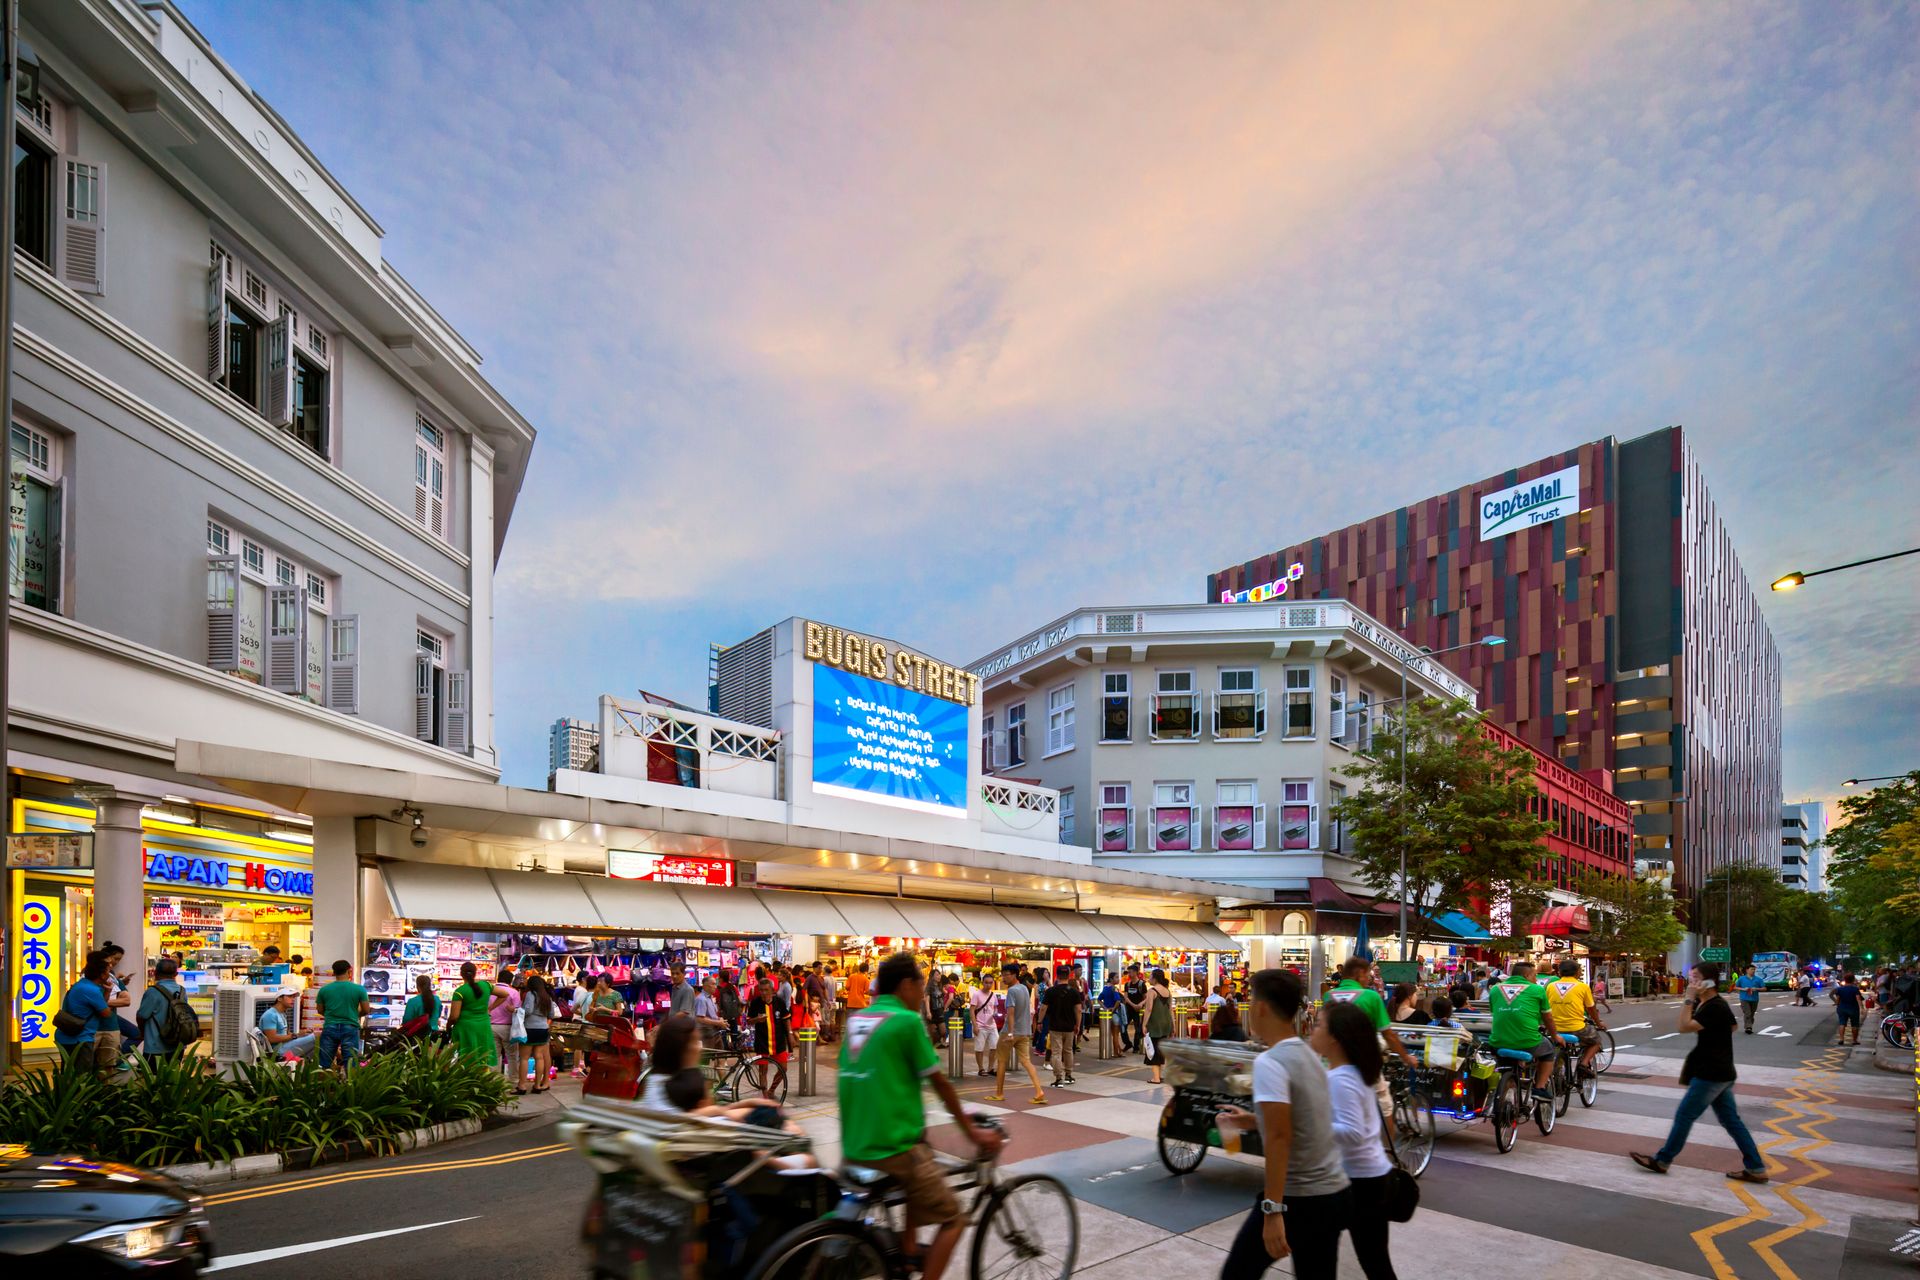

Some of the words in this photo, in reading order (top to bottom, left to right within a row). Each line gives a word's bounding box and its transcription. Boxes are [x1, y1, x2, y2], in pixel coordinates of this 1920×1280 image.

[1484, 478, 1561, 519] CapitaMall
[1528, 507, 1560, 524] Trust
[804, 620, 887, 679] BUGIS
[893, 650, 979, 706] STREET
[866, 715, 899, 732] CREATED
[847, 726, 878, 742] REALITY
[245, 862, 314, 895] HOME
[153, 906, 175, 916] SUPER
[181, 906, 202, 918] SUPER
